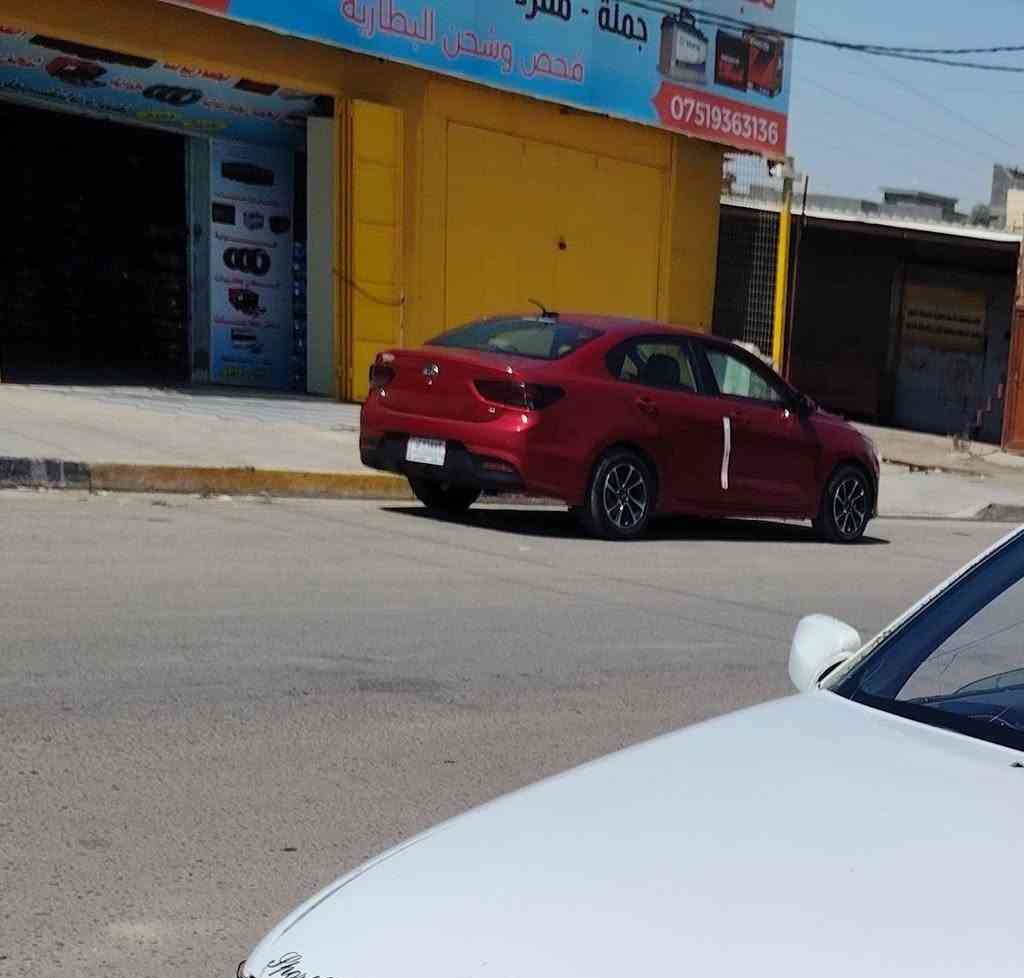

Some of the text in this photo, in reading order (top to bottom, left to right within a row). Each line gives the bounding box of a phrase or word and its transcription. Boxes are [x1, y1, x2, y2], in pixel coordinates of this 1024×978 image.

[342, 0, 584, 81] فحص وشحن البطارية
[598, 0, 647, 51] جملة
[670, 95, 778, 144] 07519363136
